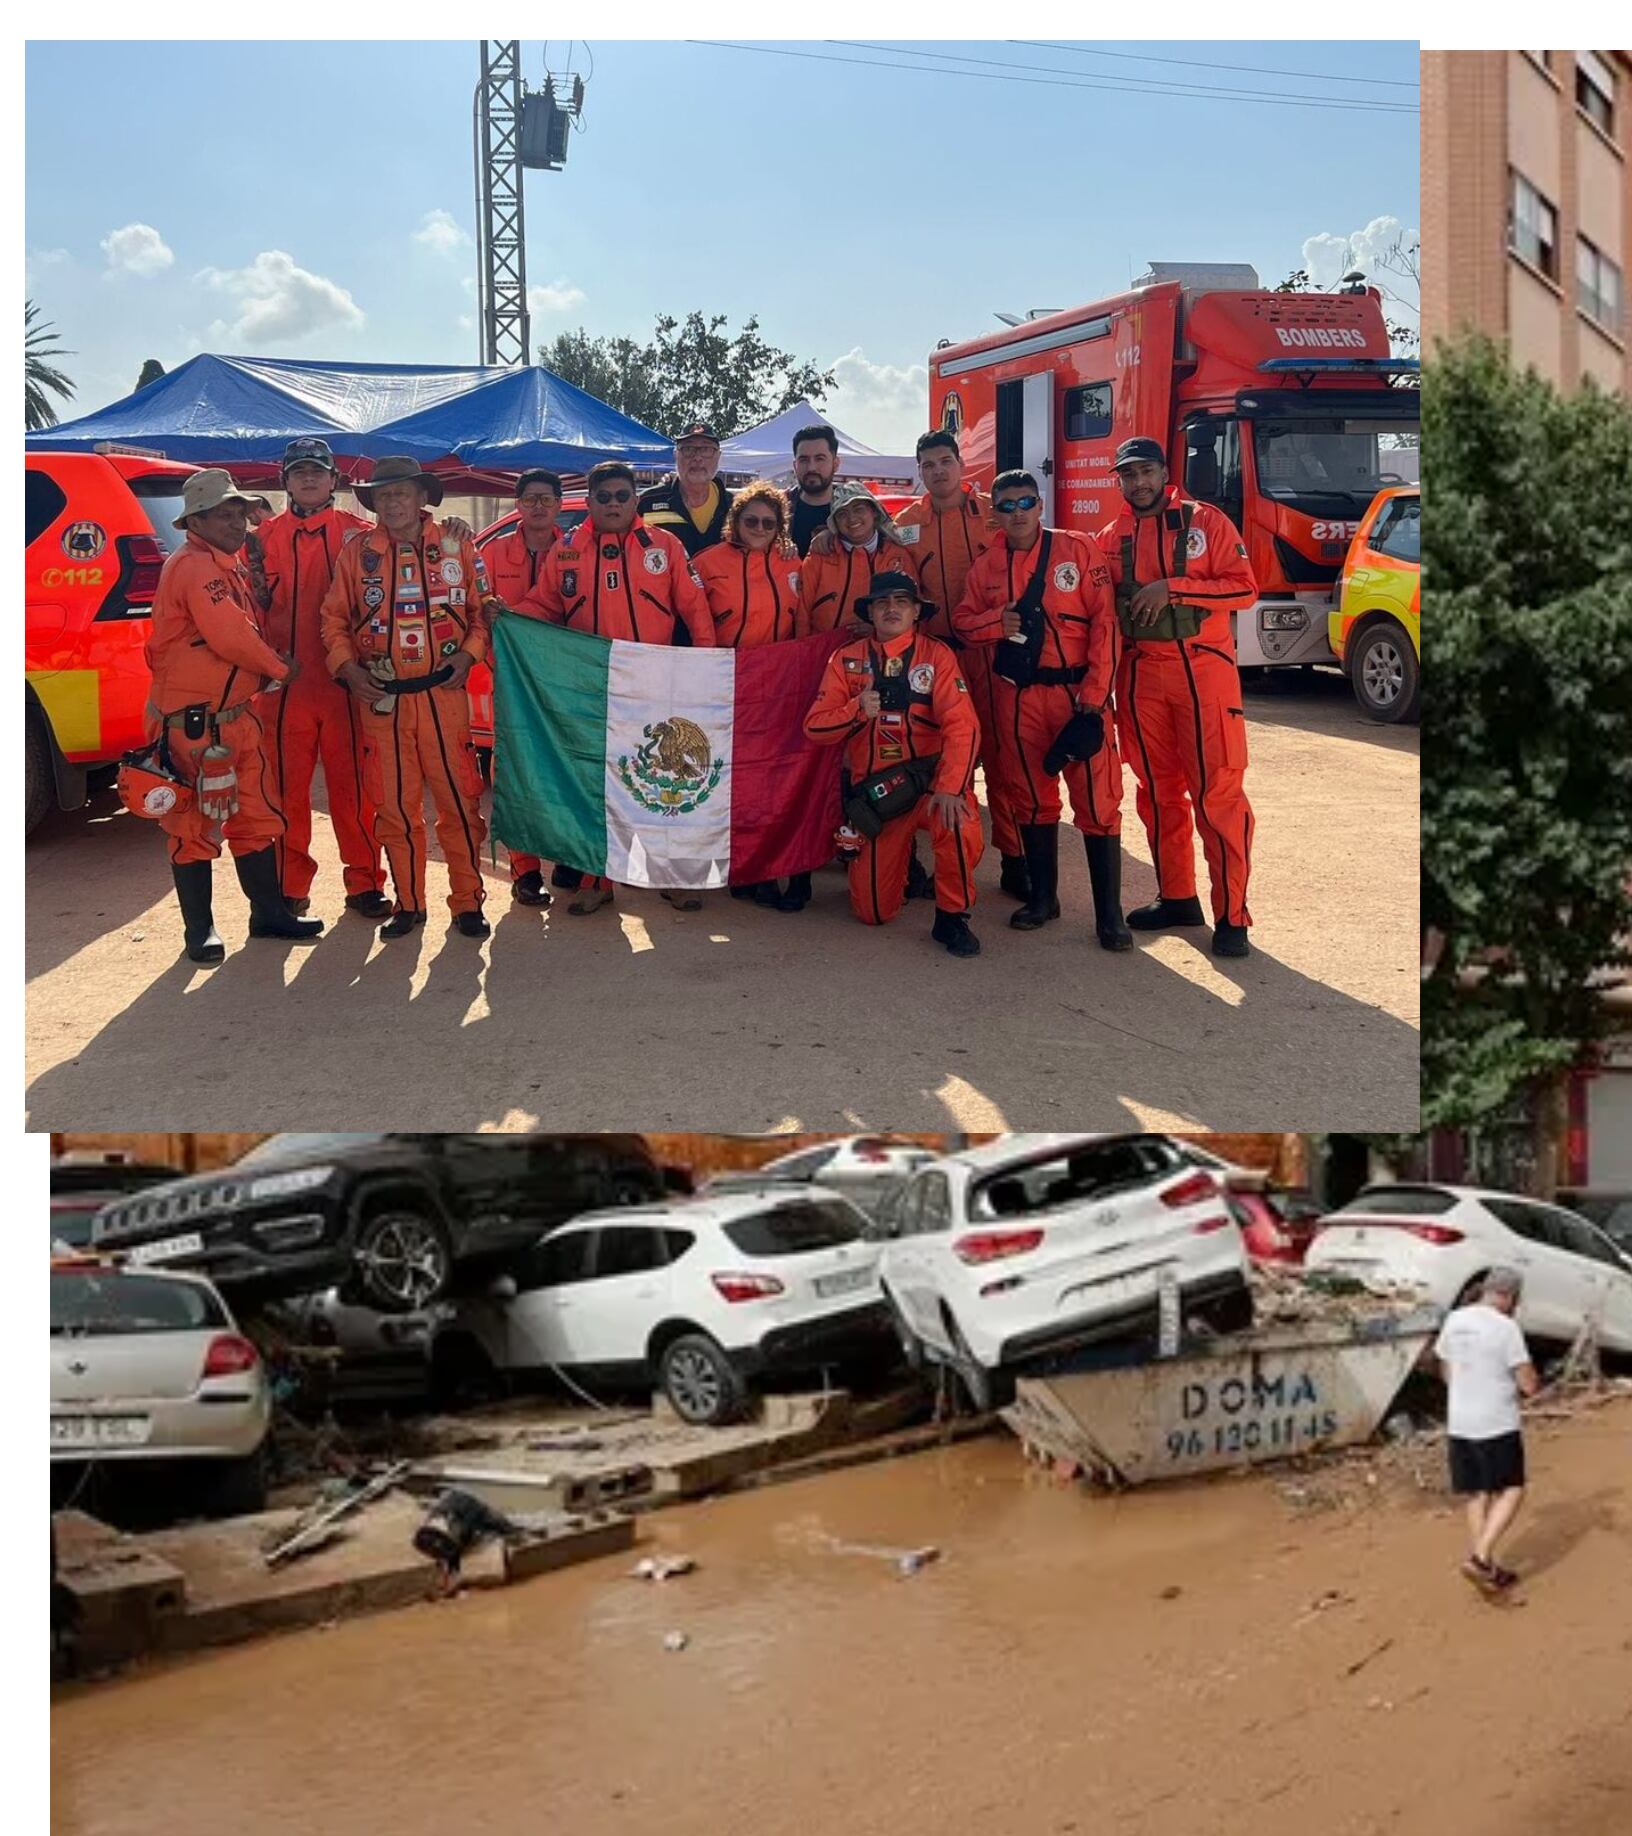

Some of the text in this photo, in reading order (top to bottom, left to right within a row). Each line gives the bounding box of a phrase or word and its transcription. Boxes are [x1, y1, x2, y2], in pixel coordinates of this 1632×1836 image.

[1275, 327, 1367, 348] BOMBERS
[1090, 456, 1110, 467] MOBIL
[1066, 477, 1116, 489] COMANDAMENT
[1072, 499, 1100, 514] 28900
[64, 568, 102, 586] 112
[1182, 1373, 1318, 1420] DOMA
